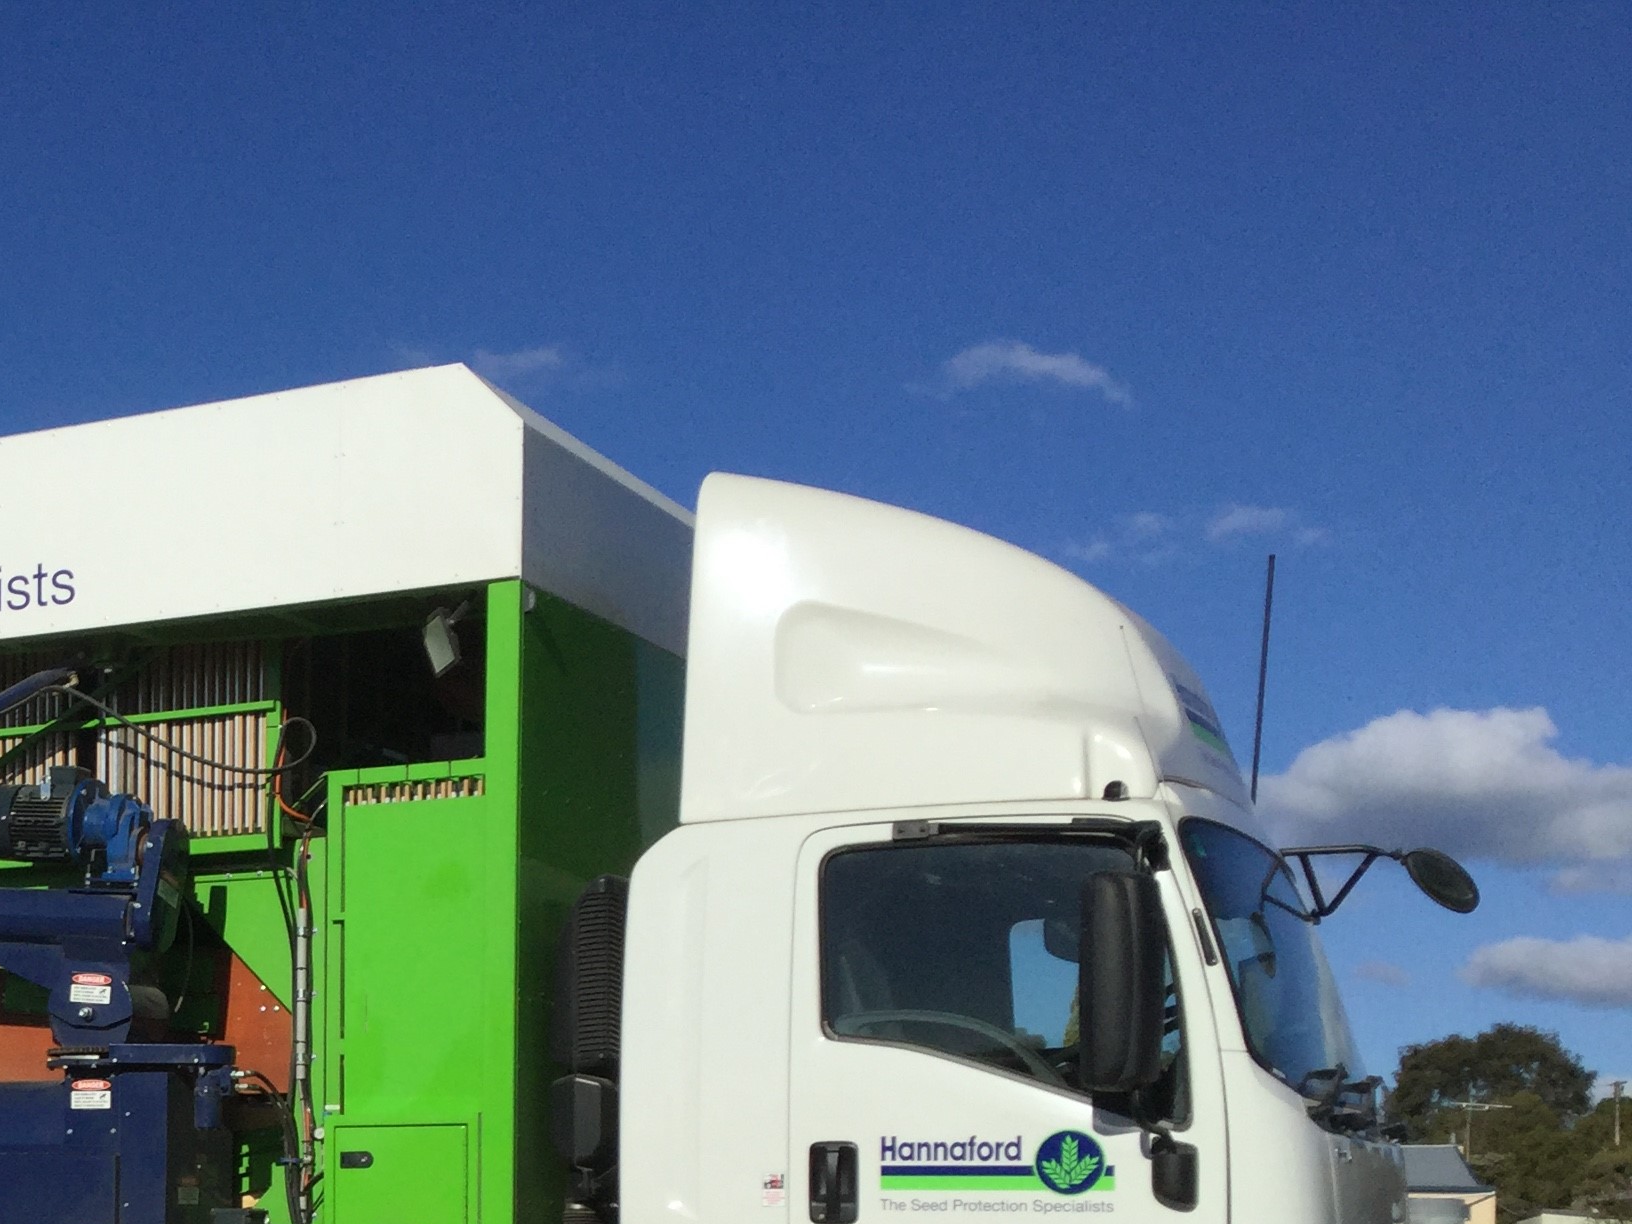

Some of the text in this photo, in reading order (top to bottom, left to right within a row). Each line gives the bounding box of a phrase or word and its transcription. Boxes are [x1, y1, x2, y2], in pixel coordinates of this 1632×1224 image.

[880, 1135, 1023, 1161] Hannaford
[880, 1199, 1115, 1215] The Seed Protection Specialists
